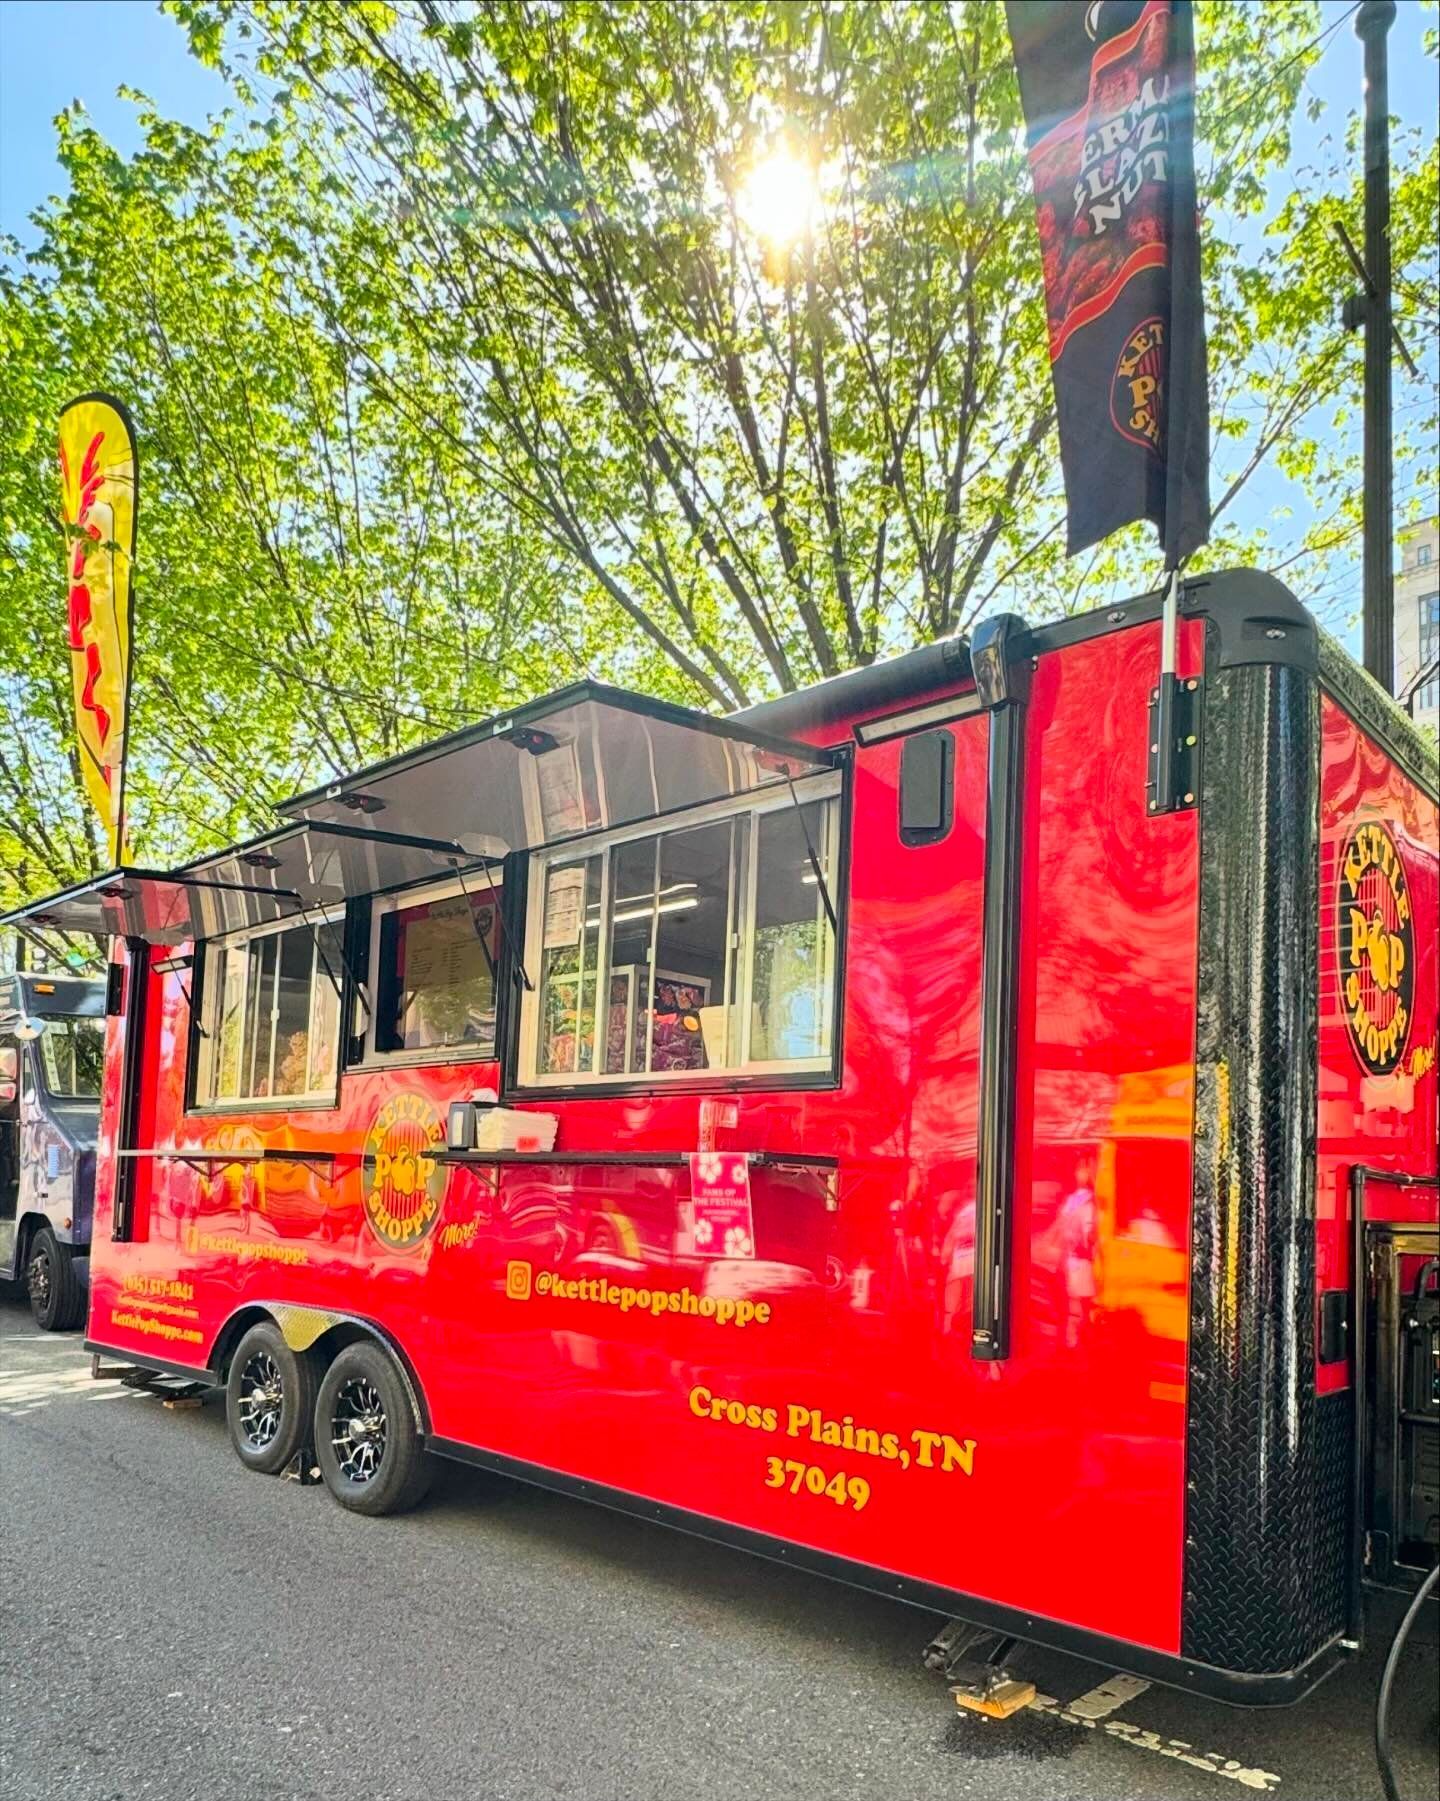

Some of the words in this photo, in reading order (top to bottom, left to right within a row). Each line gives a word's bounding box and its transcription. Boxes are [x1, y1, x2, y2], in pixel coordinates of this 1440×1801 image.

[1343, 825, 1410, 930] KETTLE
[1346, 972, 1407, 1066] SHOPPE
[371, 1094, 442, 1149] KETTLE
[368, 1191, 437, 1242] SHOPPE
[438, 1211, 482, 1252] More!
[535, 1272, 771, 1327] @kettlepopshoppe
[688, 1386, 777, 1432] Cross
[764, 1456, 871, 1512] 37049
